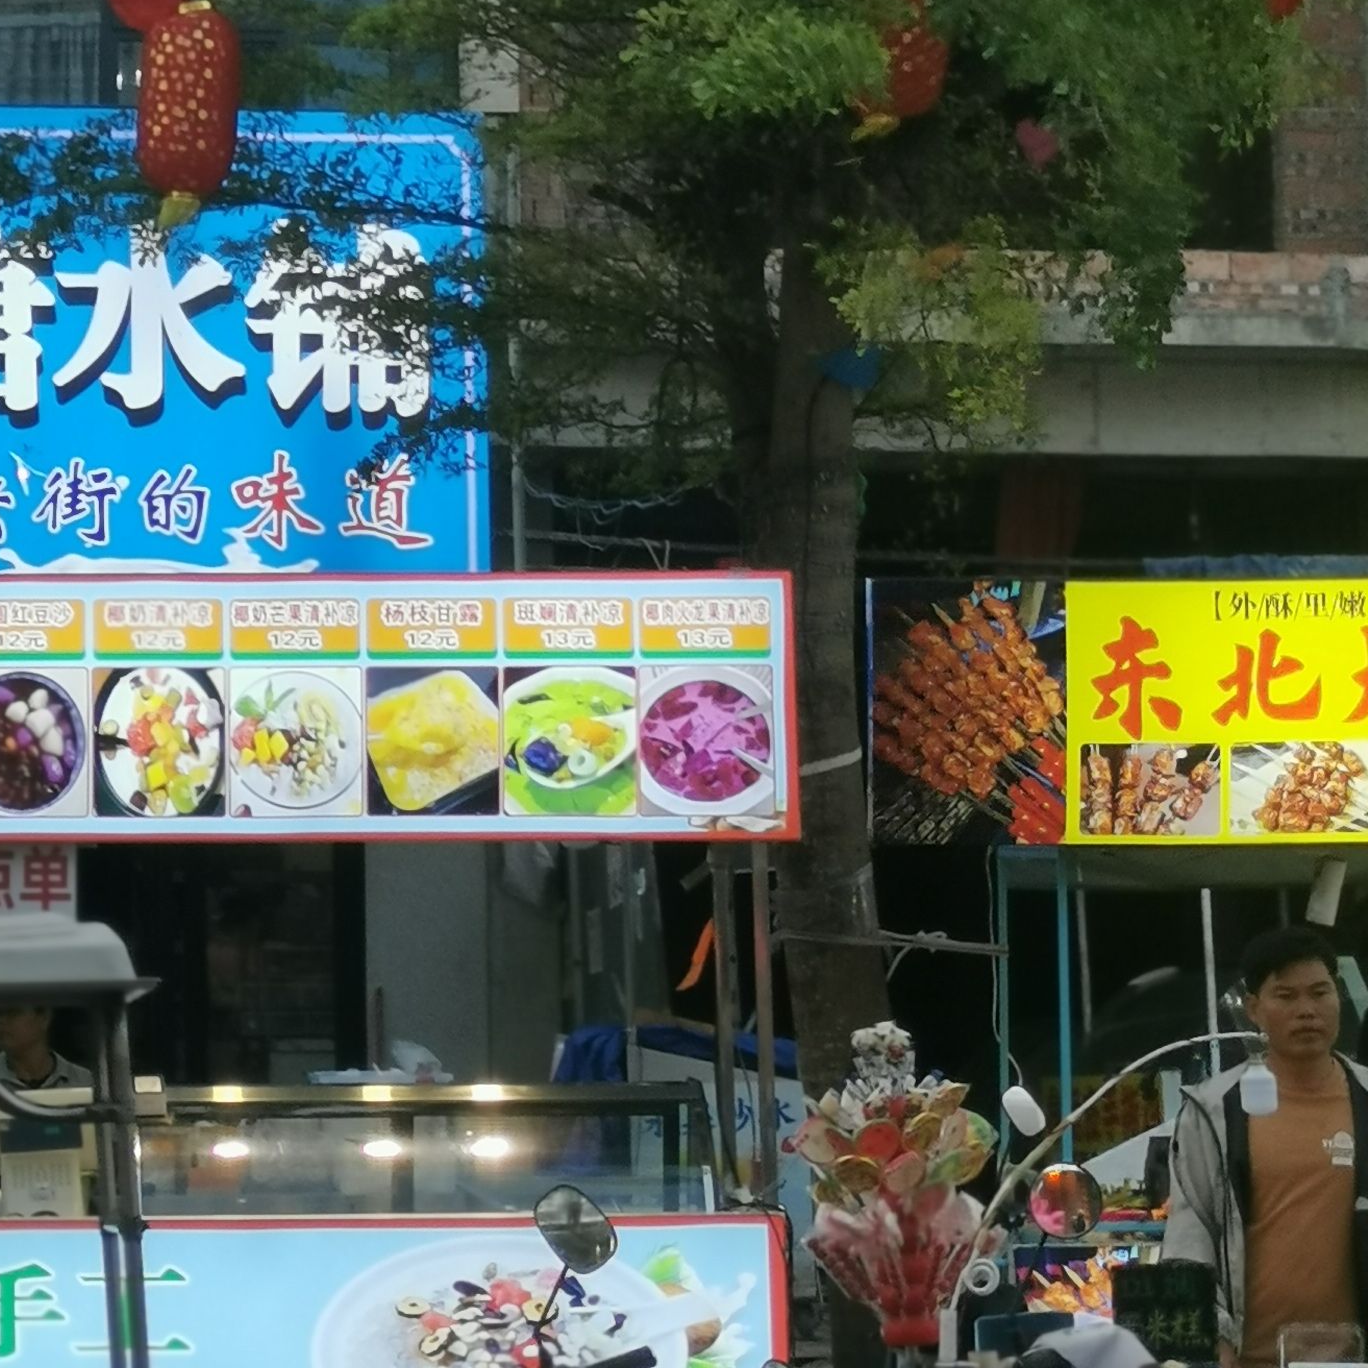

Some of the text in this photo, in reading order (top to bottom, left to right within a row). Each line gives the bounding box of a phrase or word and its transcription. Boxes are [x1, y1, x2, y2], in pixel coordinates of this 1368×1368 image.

[105, 602, 212, 626] 椰奶清补凉
[233, 601, 358, 626] 椰奶芒果清补凉
[382, 601, 481, 626] 杨枝甘露
[132, 631, 185, 650] 12元
[269, 631, 321, 649] 12元
[405, 630, 459, 649] 12元
[542, 630, 595, 648] 13元
[678, 629, 731, 648] 13元
[1091, 615, 1368, 740] 东北
